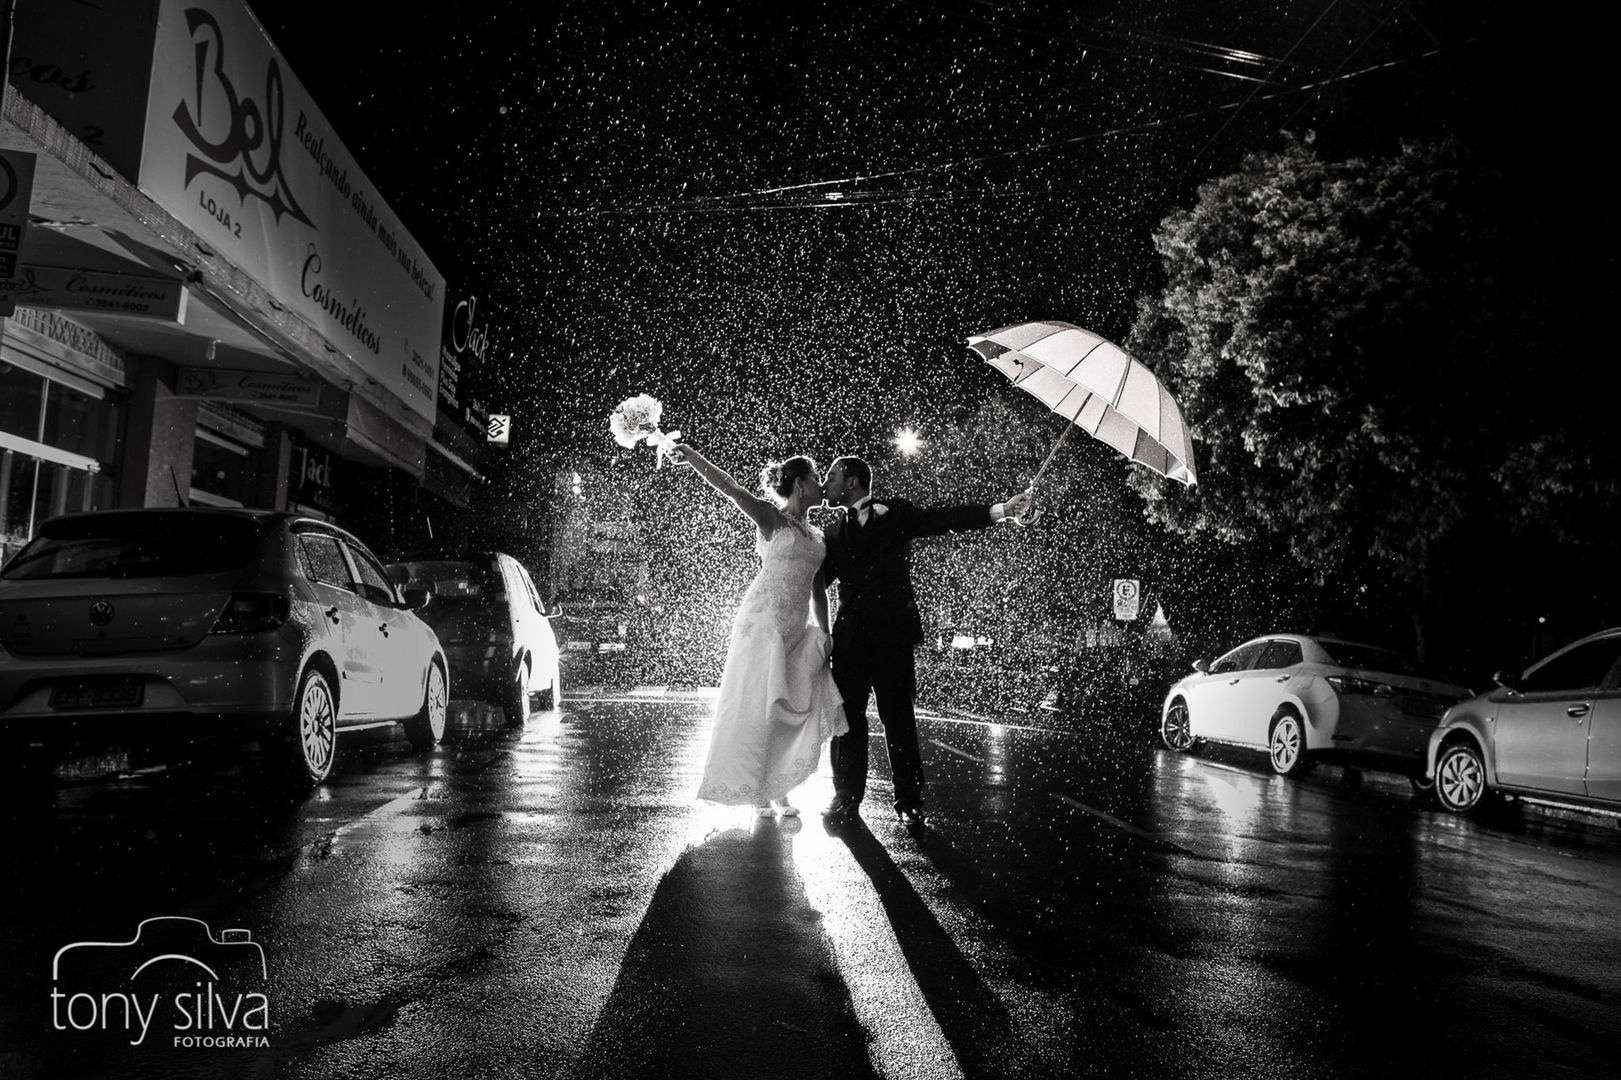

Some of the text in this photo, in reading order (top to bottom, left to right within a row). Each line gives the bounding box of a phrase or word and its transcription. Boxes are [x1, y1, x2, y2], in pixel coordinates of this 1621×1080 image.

[172, 8, 284, 185] Bel
[82, 125, 104, 145] 2
[200, 190, 242, 239] LOJA 2
[295, 110, 351, 200] Realçando
[351, 190, 377, 233] ainda
[378, 223, 397, 257] mais
[398, 247, 412, 274] sua
[301, 242, 382, 355] Cosméticos
[452, 295, 489, 364] Jack
[298, 447, 333, 489] Jack
